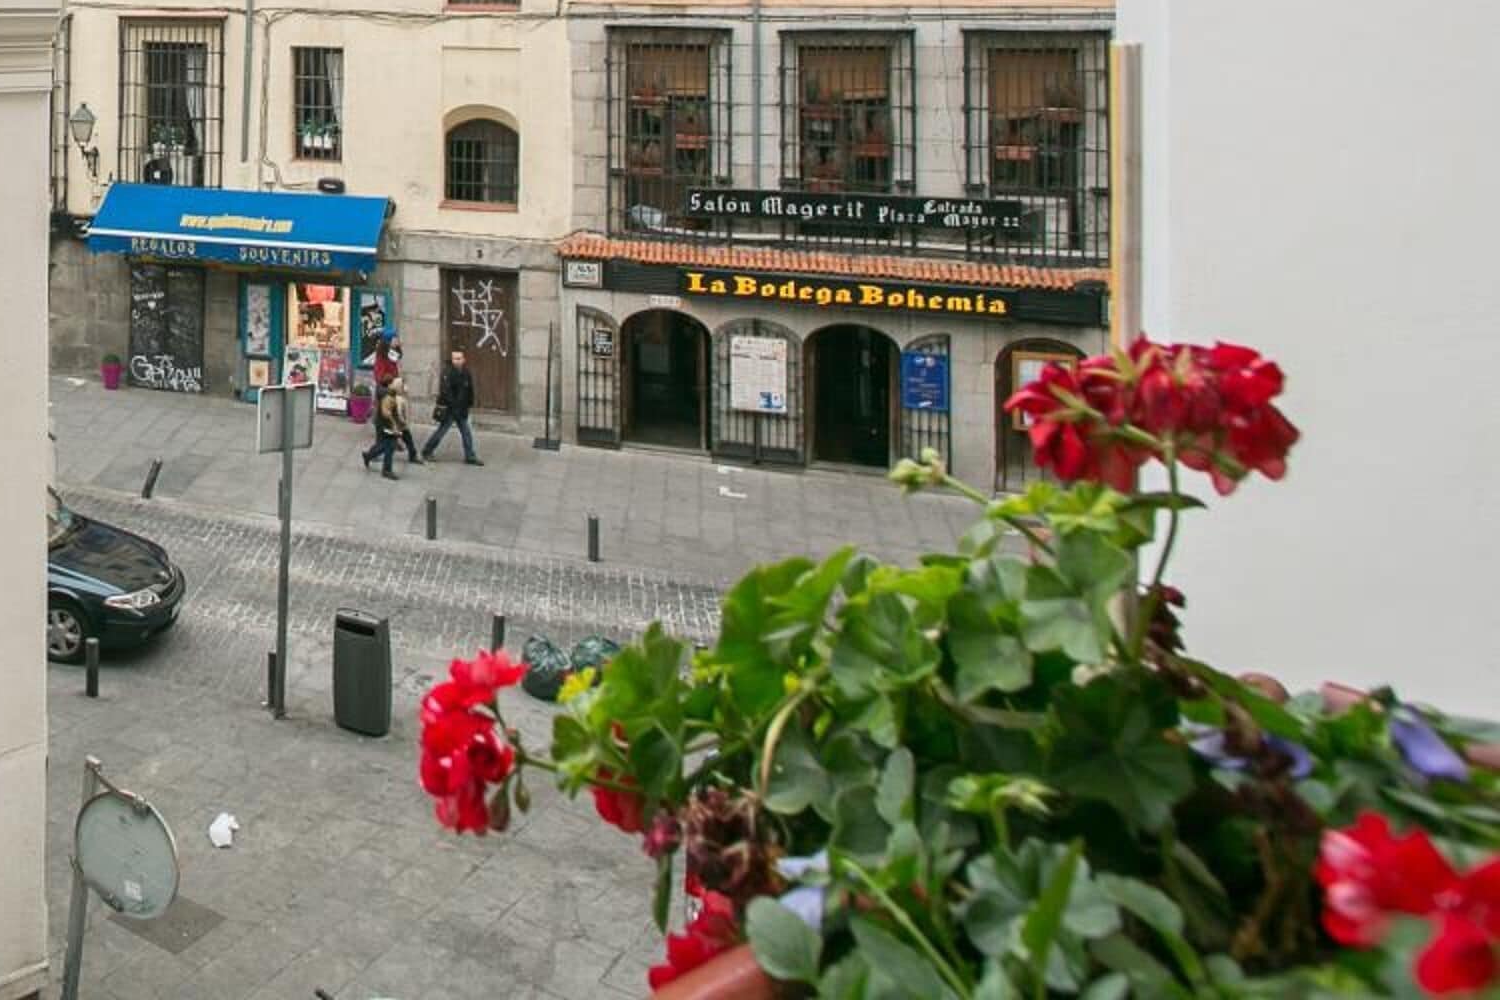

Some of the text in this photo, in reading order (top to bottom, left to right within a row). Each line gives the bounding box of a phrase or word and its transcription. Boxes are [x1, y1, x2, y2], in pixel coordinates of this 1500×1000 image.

[761, 195, 865, 220] Magerit
[943, 213, 996, 229] Mayor
[131, 236, 333, 266] REGALOS SOUVENIRS
[685, 272, 1007, 314] La Bodega Bohemia
